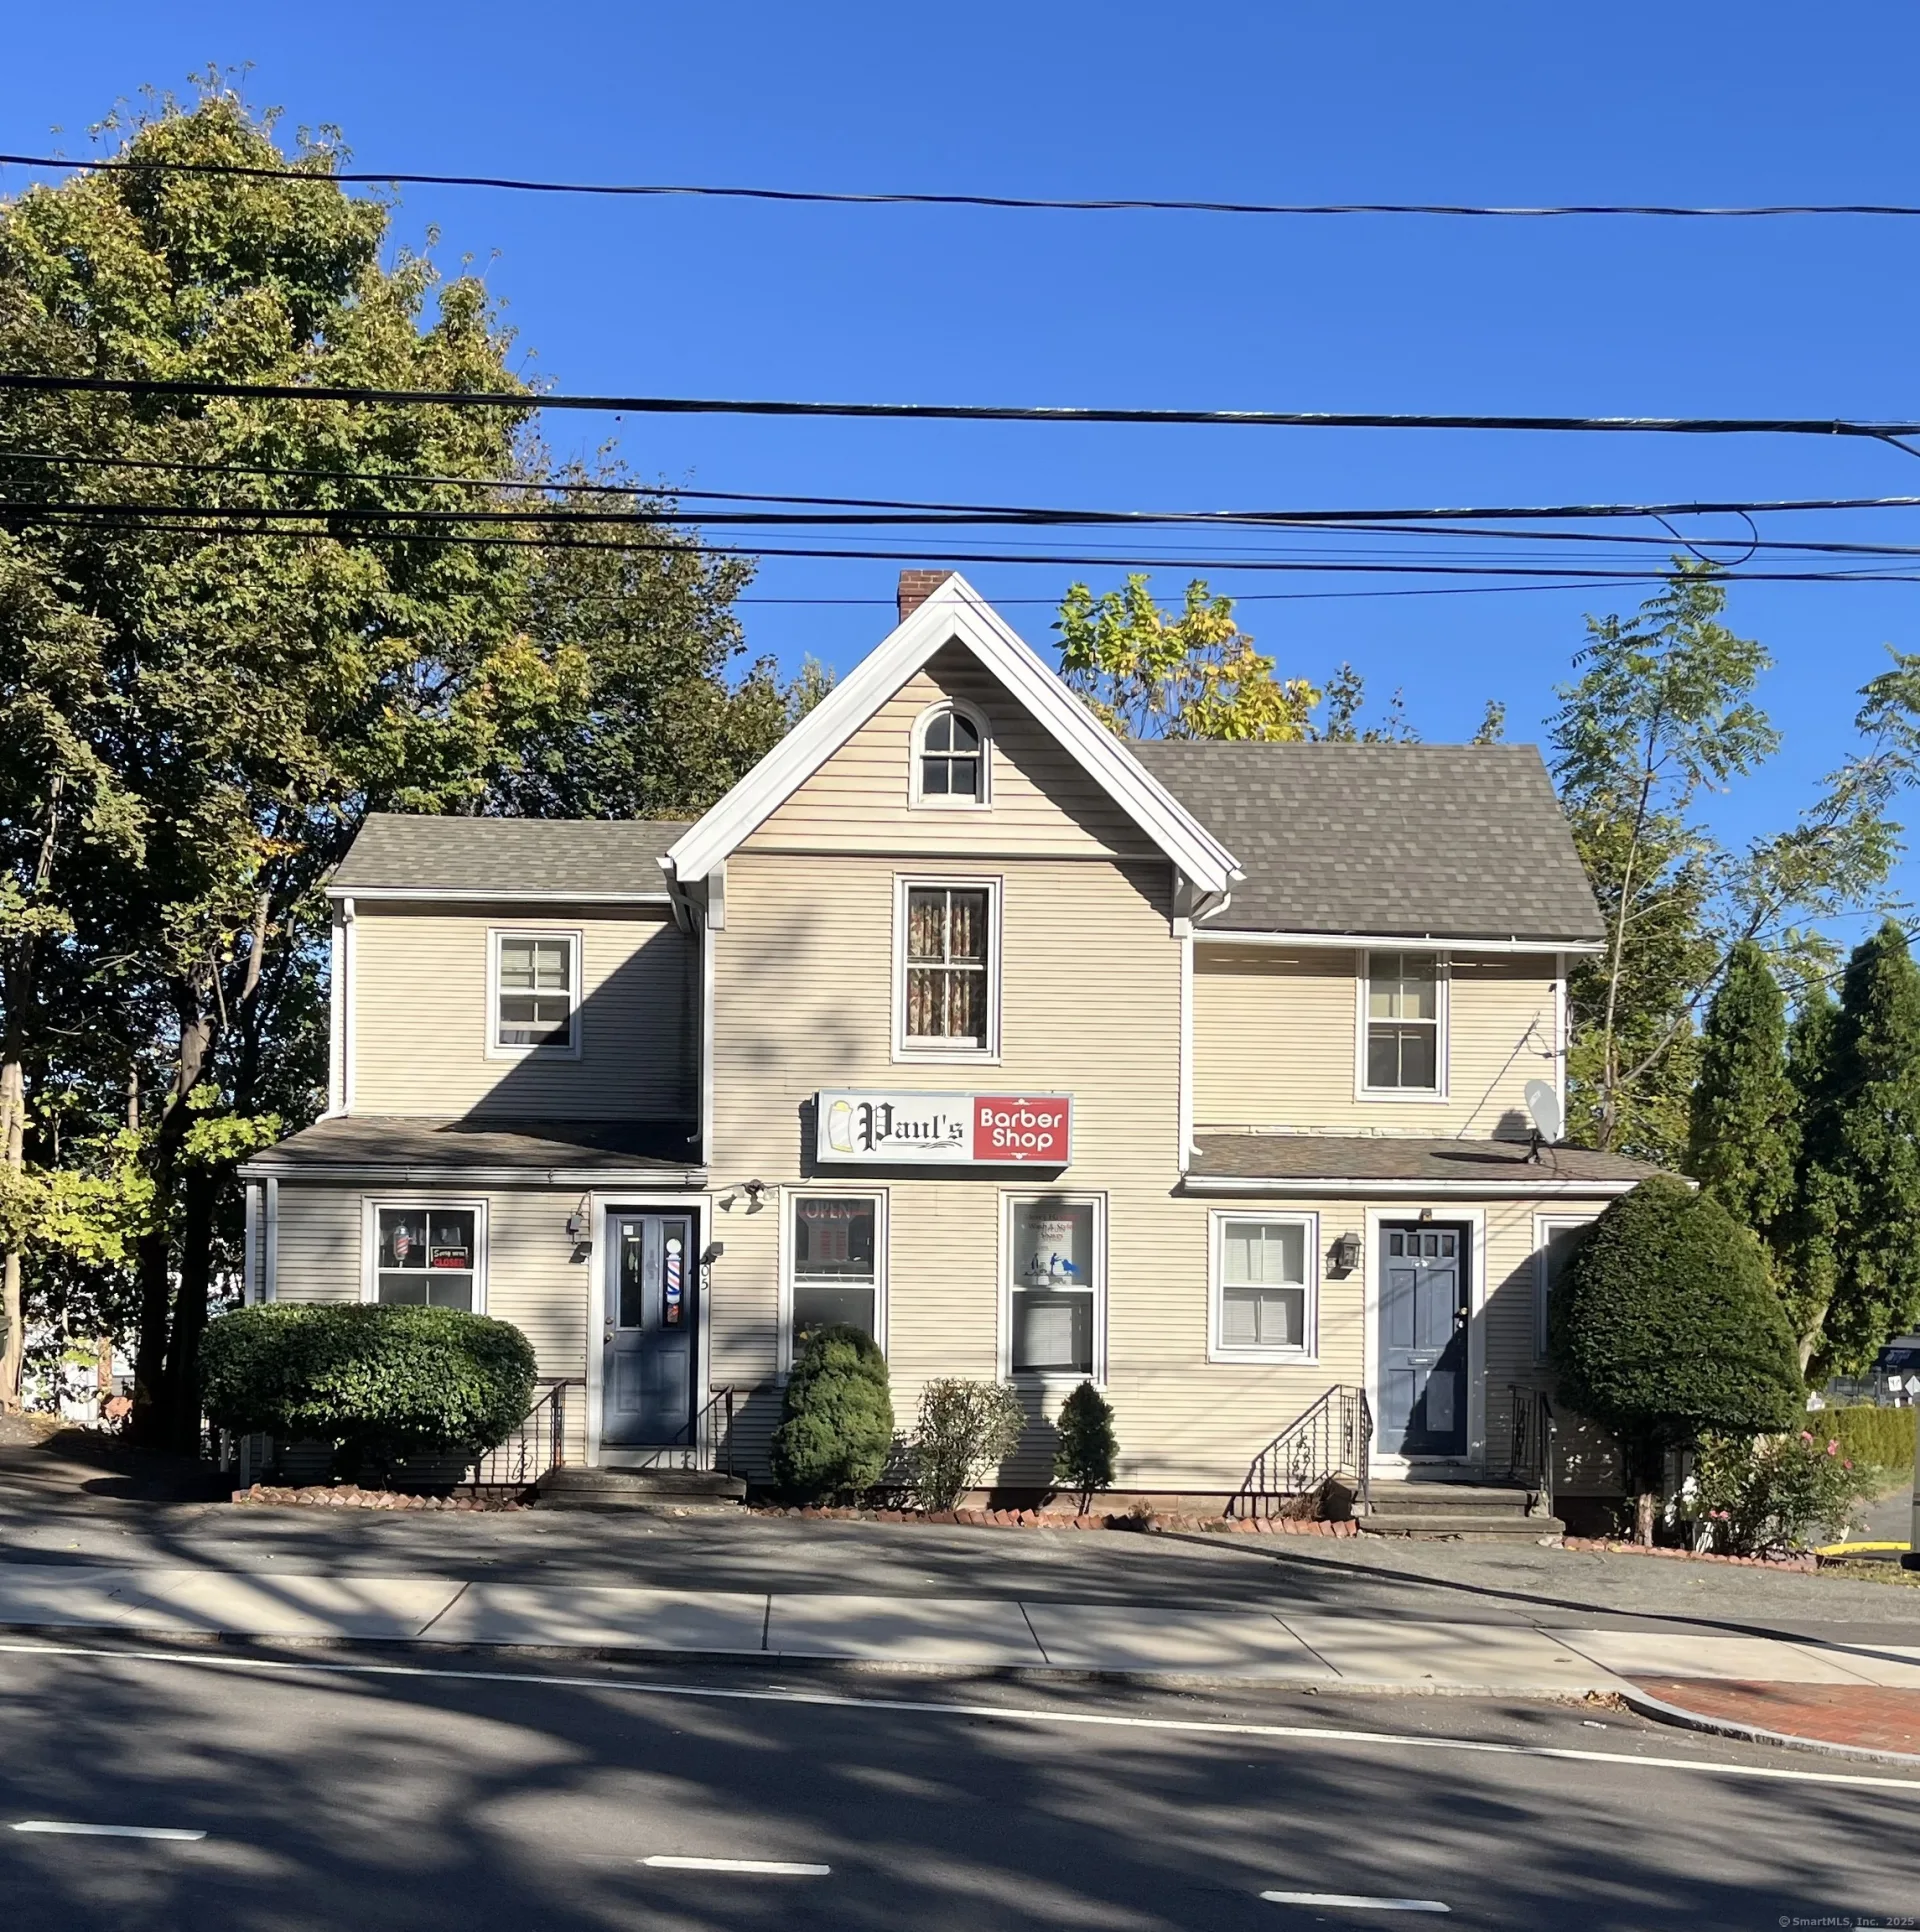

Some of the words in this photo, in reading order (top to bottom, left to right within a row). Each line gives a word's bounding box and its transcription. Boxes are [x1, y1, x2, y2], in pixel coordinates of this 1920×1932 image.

[857, 1102, 963, 1151] Paul's
[980, 1108, 1063, 1128] Barber
[992, 1128, 1053, 1151] Shop
[806, 1201, 850, 1218] OPEN
[434, 1258, 465, 1267] CLOSED
